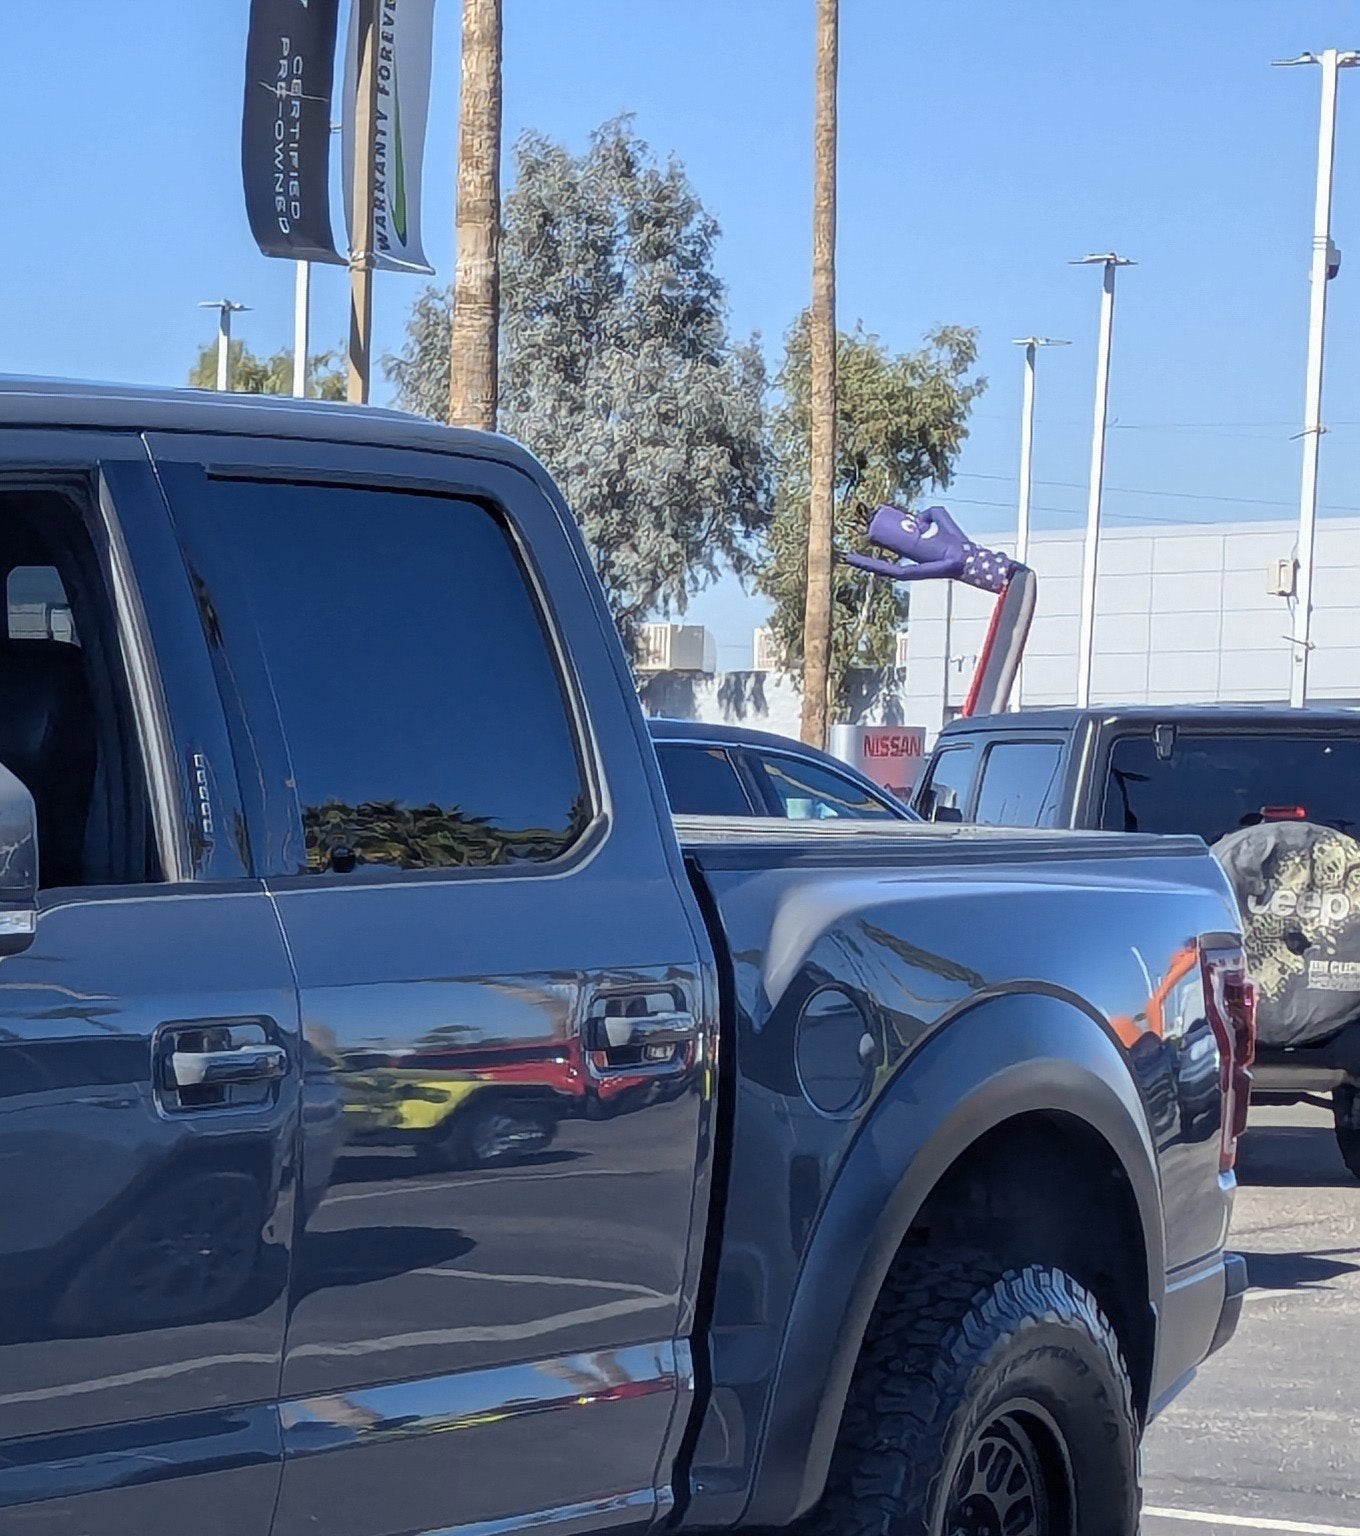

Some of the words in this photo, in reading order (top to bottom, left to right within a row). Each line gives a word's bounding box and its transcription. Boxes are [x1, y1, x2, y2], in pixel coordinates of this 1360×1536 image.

[273, 37, 290, 234] PRE-OWNED
[289, 56, 303, 219] CERTIFIED
[864, 735, 921, 757] NISSAN
[1247, 889, 1350, 926] Jeep
